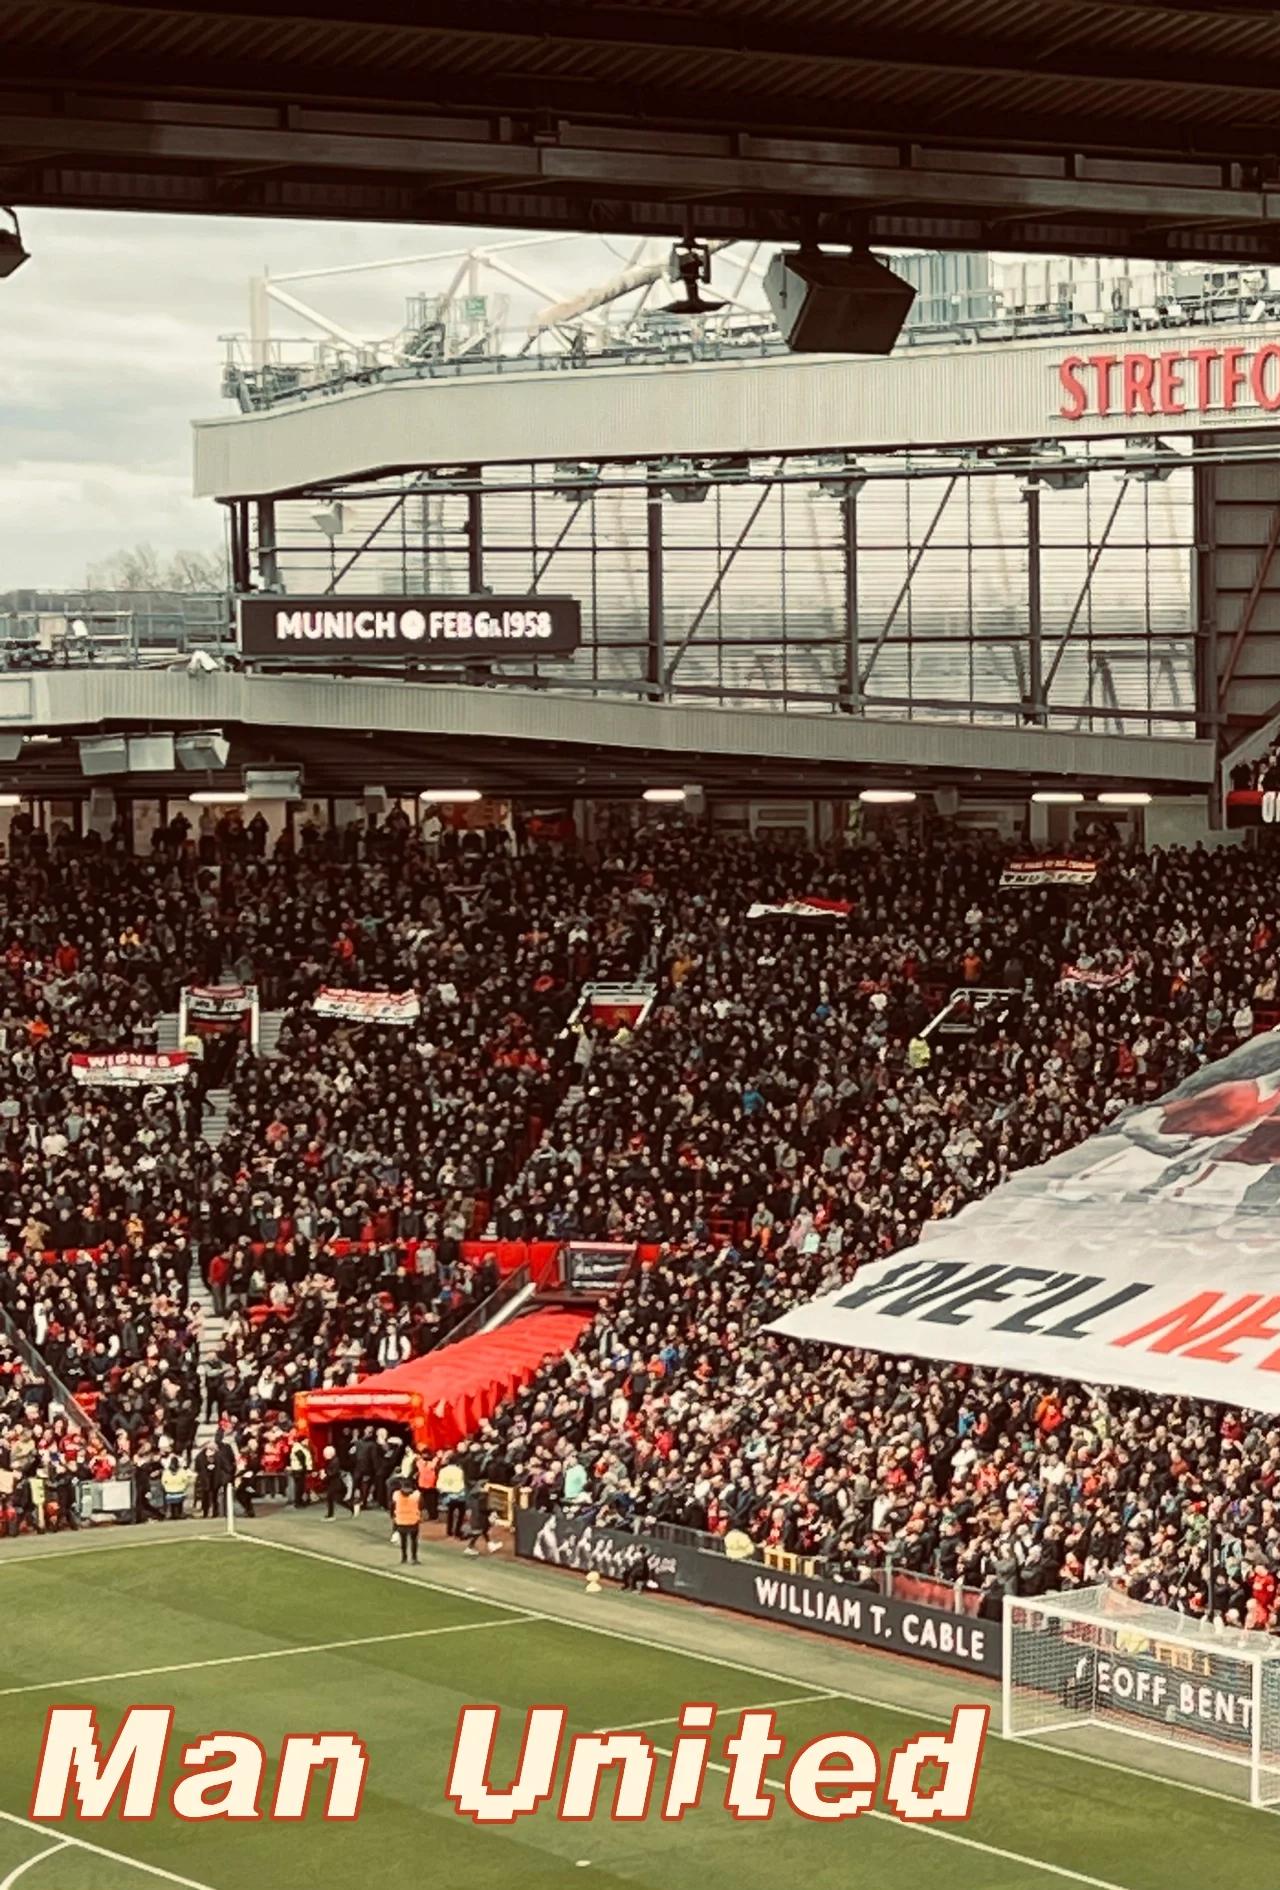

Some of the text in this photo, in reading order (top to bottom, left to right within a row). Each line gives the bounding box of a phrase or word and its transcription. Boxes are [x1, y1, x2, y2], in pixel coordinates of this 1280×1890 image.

[276, 611, 397, 639] MUNICH
[503, 611, 552, 638] 1958
[834, 1260, 1155, 1340] WE'LL
[754, 1575, 861, 1629] WILLIAM
[902, 1613, 985, 1661] CABLE
[1179, 1681, 1253, 1730] BENT
